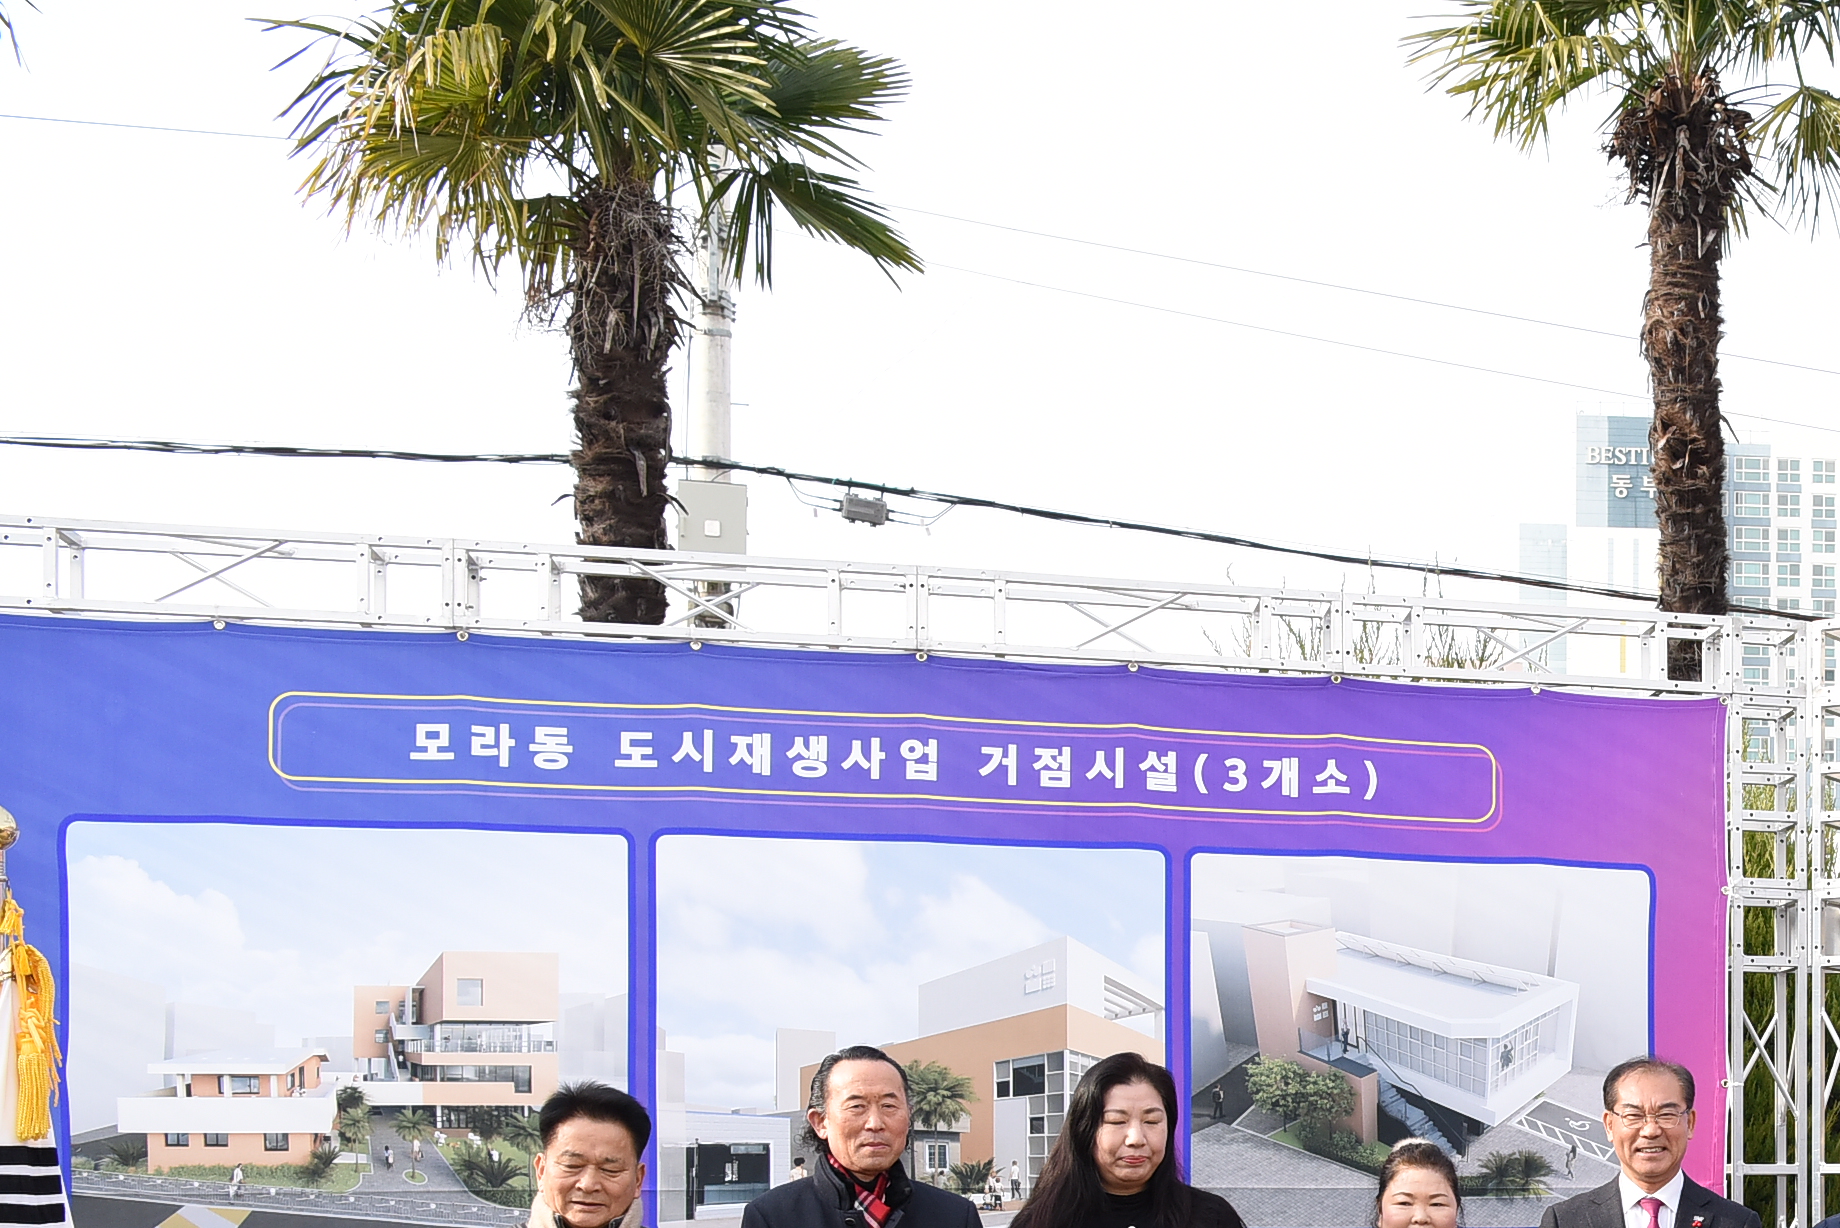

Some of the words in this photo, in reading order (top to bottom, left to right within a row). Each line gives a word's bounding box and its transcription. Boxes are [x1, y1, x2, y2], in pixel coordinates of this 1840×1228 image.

[1586, 446, 1655, 465] BESTI
[409, 723, 574, 770] 모라동
[614, 729, 938, 781] 도시재생사업
[978, 743, 1378, 801] 거점시설(3개소)
